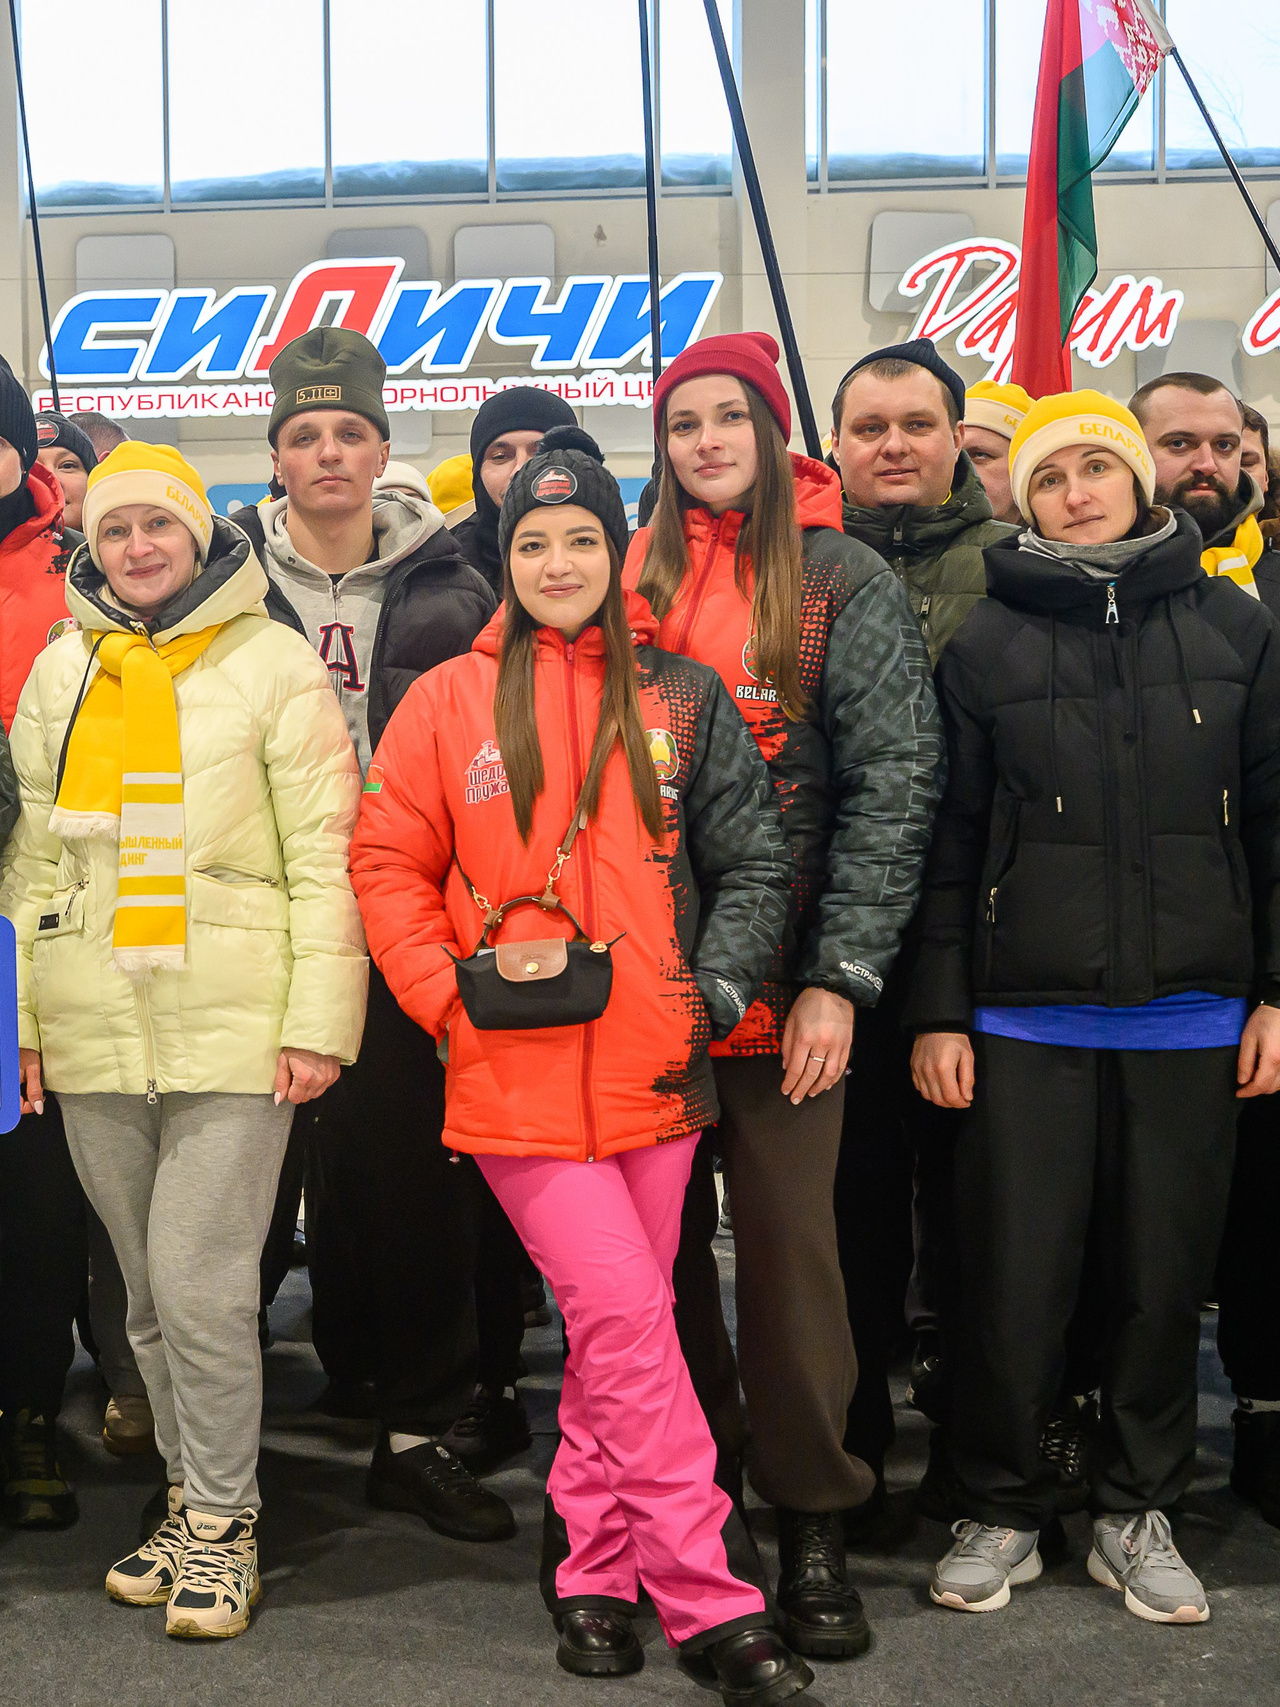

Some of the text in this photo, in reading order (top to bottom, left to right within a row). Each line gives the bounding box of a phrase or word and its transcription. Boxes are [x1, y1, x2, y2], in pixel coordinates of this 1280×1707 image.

[38, 391, 274, 413] РЕСПУБЛИКАН
[1079, 422, 1151, 476] БЕЛАРУС
[166, 485, 209, 544] БЕЛАРУС
[735, 685, 778, 702] BELAR
[466, 779, 508, 804] Пружа
[660, 785, 678, 801] ARUS
[120, 833, 183, 850] ЫШЛЕННЫЙ
[119, 852, 148, 868] ДИНГ
